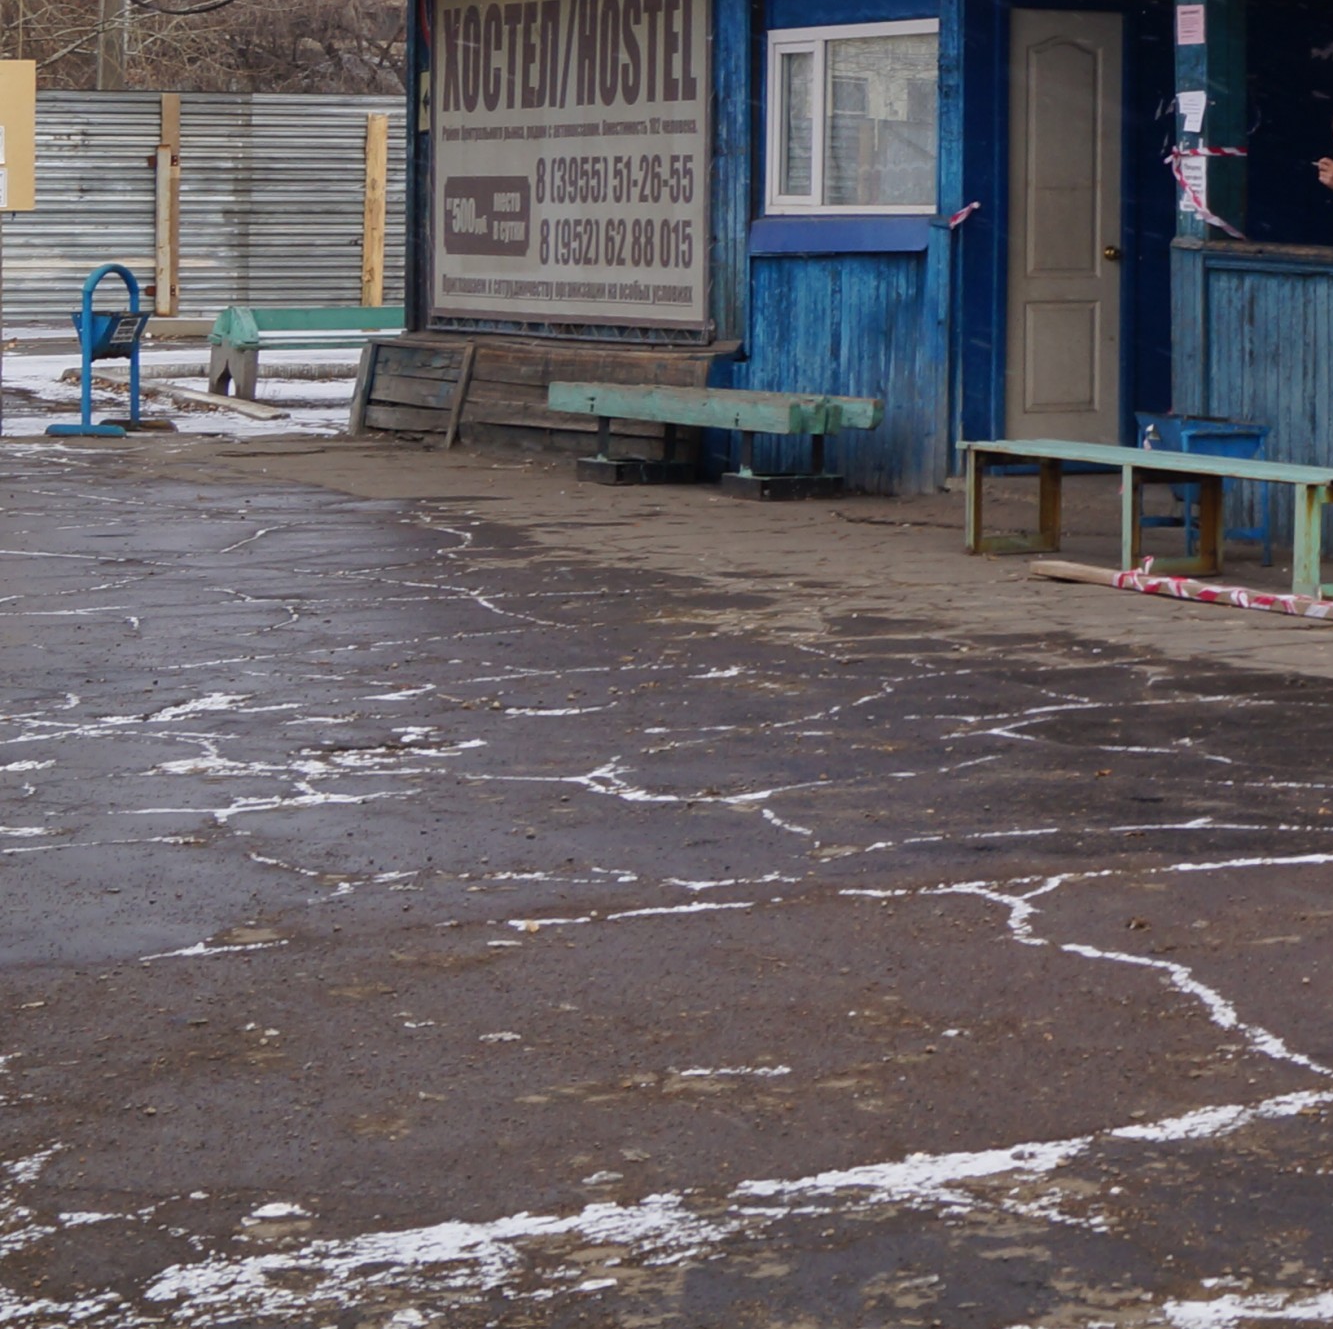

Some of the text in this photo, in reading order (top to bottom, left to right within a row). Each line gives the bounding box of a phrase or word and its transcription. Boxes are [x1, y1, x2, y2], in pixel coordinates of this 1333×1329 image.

[536, 154, 694, 204] 8 (3955) 51-26-55
[452, 197, 476, 233] 500
[540, 218, 693, 269] 8 (952) 62 88 015
